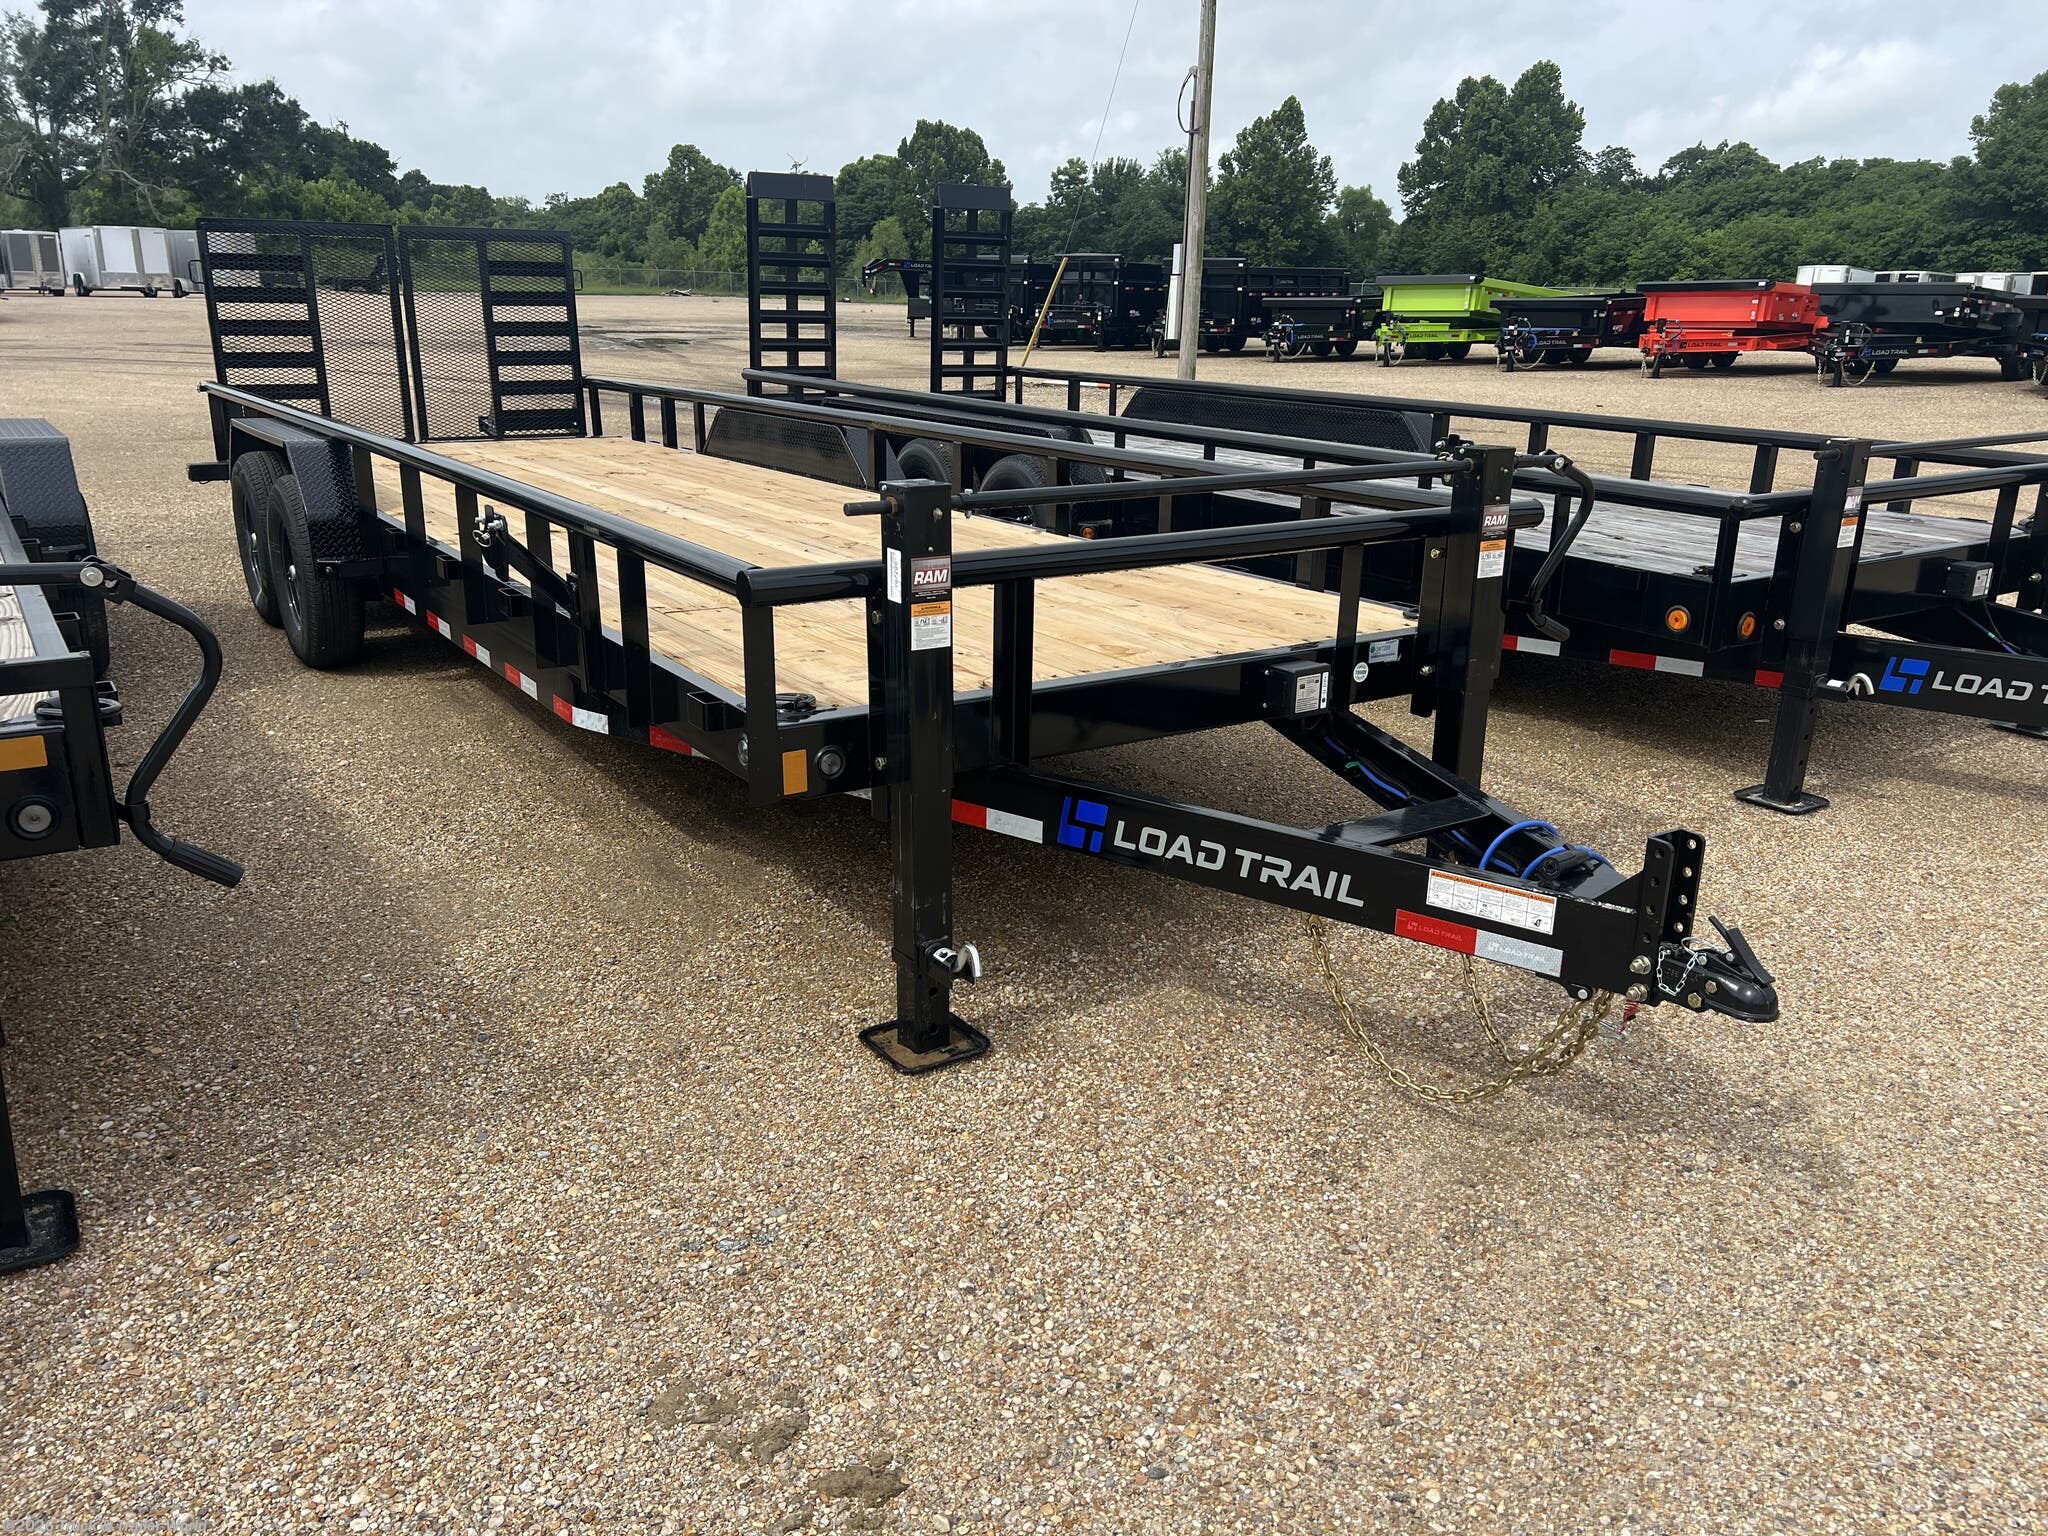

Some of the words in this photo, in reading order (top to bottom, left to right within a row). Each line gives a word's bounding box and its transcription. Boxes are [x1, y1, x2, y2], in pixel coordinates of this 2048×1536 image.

[1484, 514, 1507, 527] RAM
[913, 569, 948, 585] RAM
[1931, 670, 2034, 701] LOAD
[1113, 820, 1226, 871] LOAD
[1235, 847, 1365, 908] TRAIL
[1418, 924, 1440, 935] LOAD
